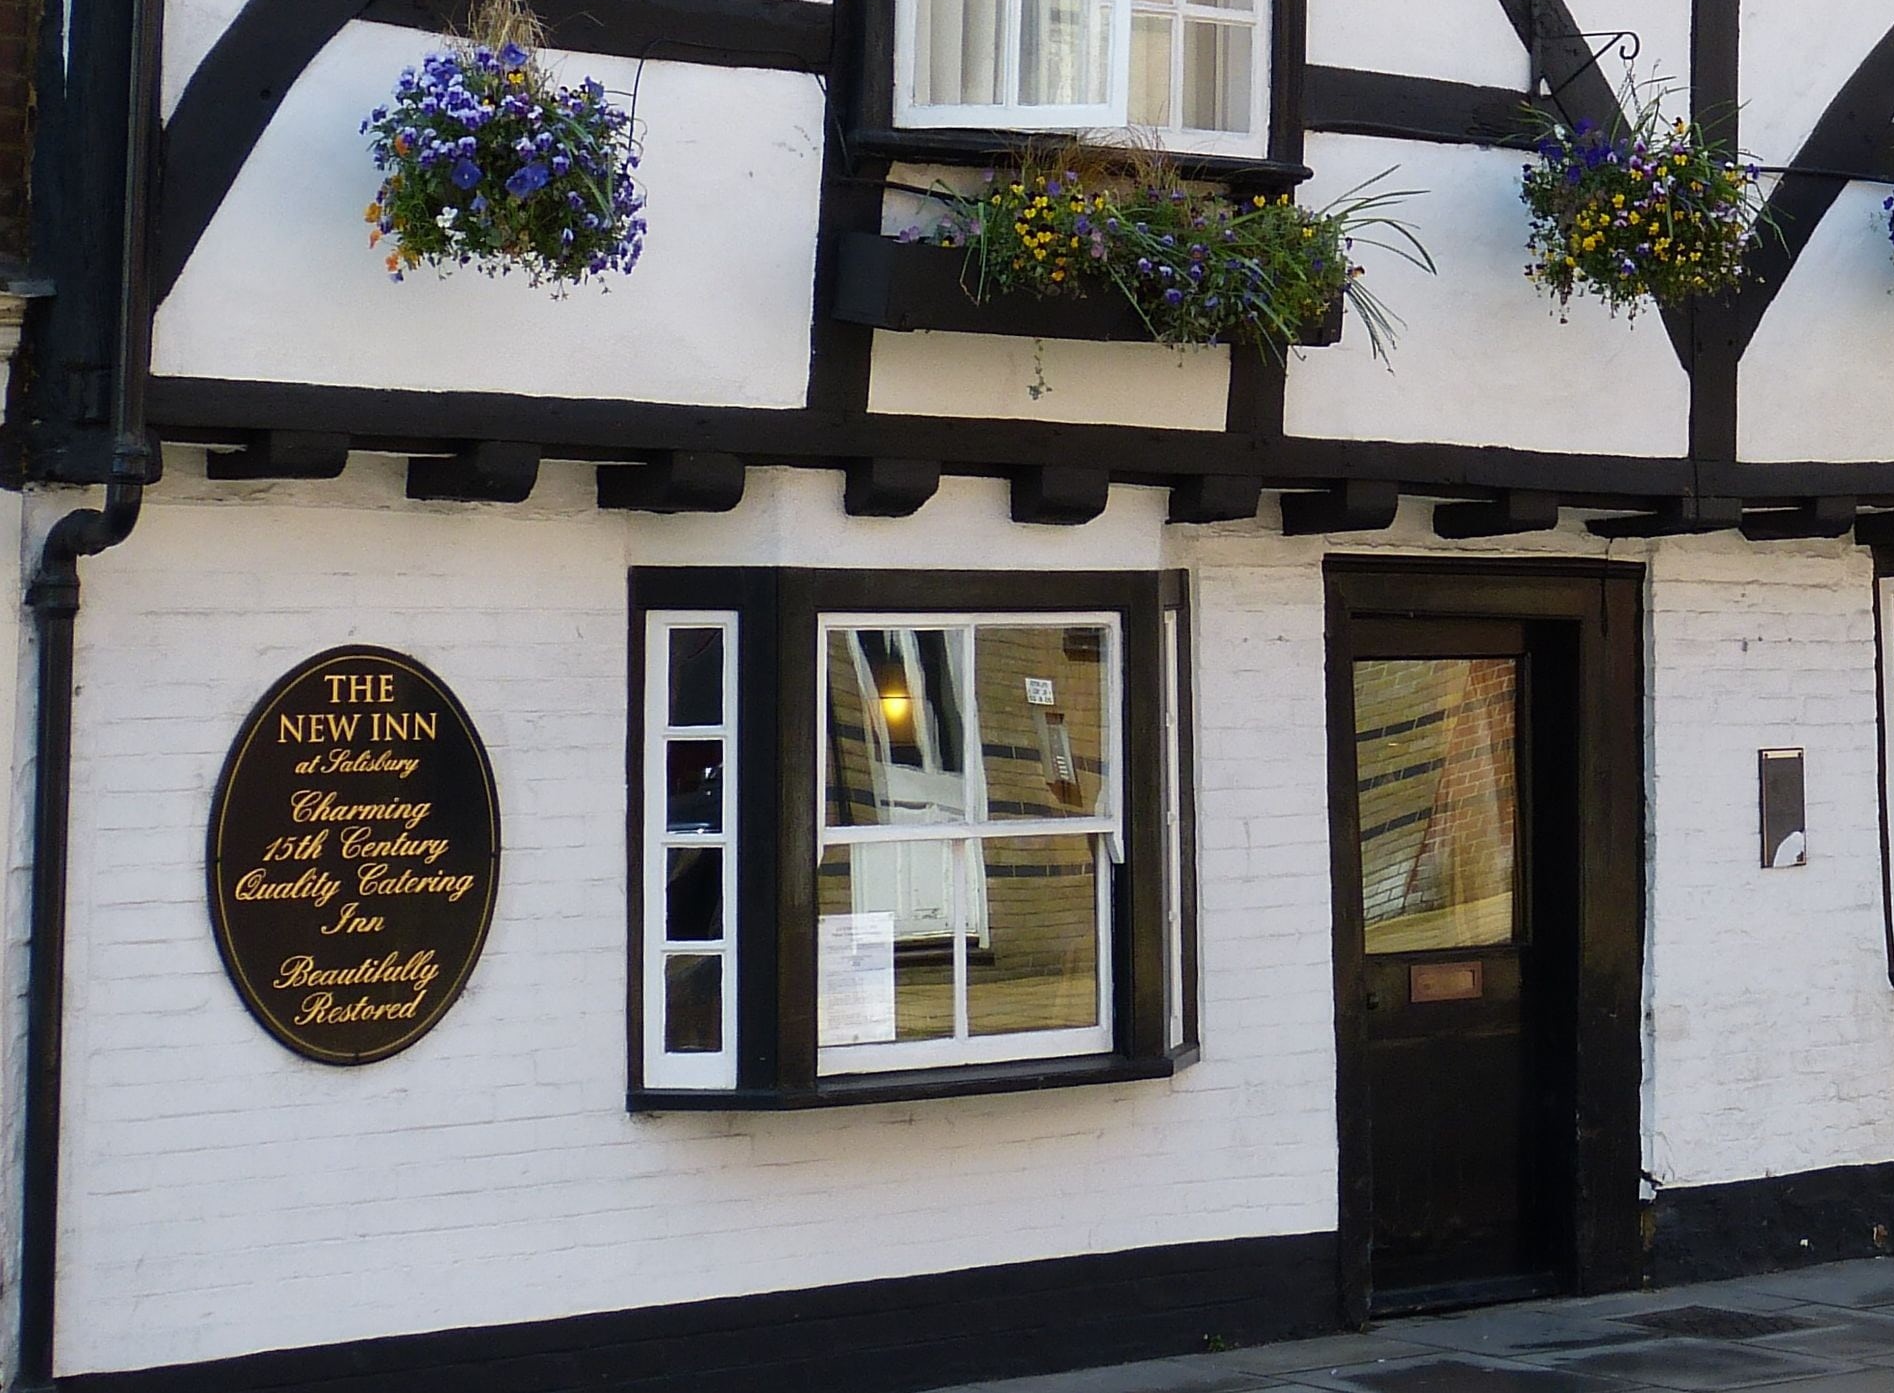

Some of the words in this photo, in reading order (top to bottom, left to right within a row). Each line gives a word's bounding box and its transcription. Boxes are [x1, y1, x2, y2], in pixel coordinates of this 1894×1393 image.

[324, 674, 395, 703] THE
[277, 714, 361, 743] NEW
[369, 712, 438, 742] INN
[295, 756, 320, 775] at
[320, 748, 419, 778] Salisbury
[290, 790, 432, 829] Charming
[262, 828, 329, 862] 15th
[340, 825, 449, 863] Century
[235, 868, 340, 907] Quality
[357, 862, 474, 902] Catering
[321, 902, 386, 935] Inn
[273, 949, 440, 990] Beautifully
[294, 989, 428, 1025] Restored
